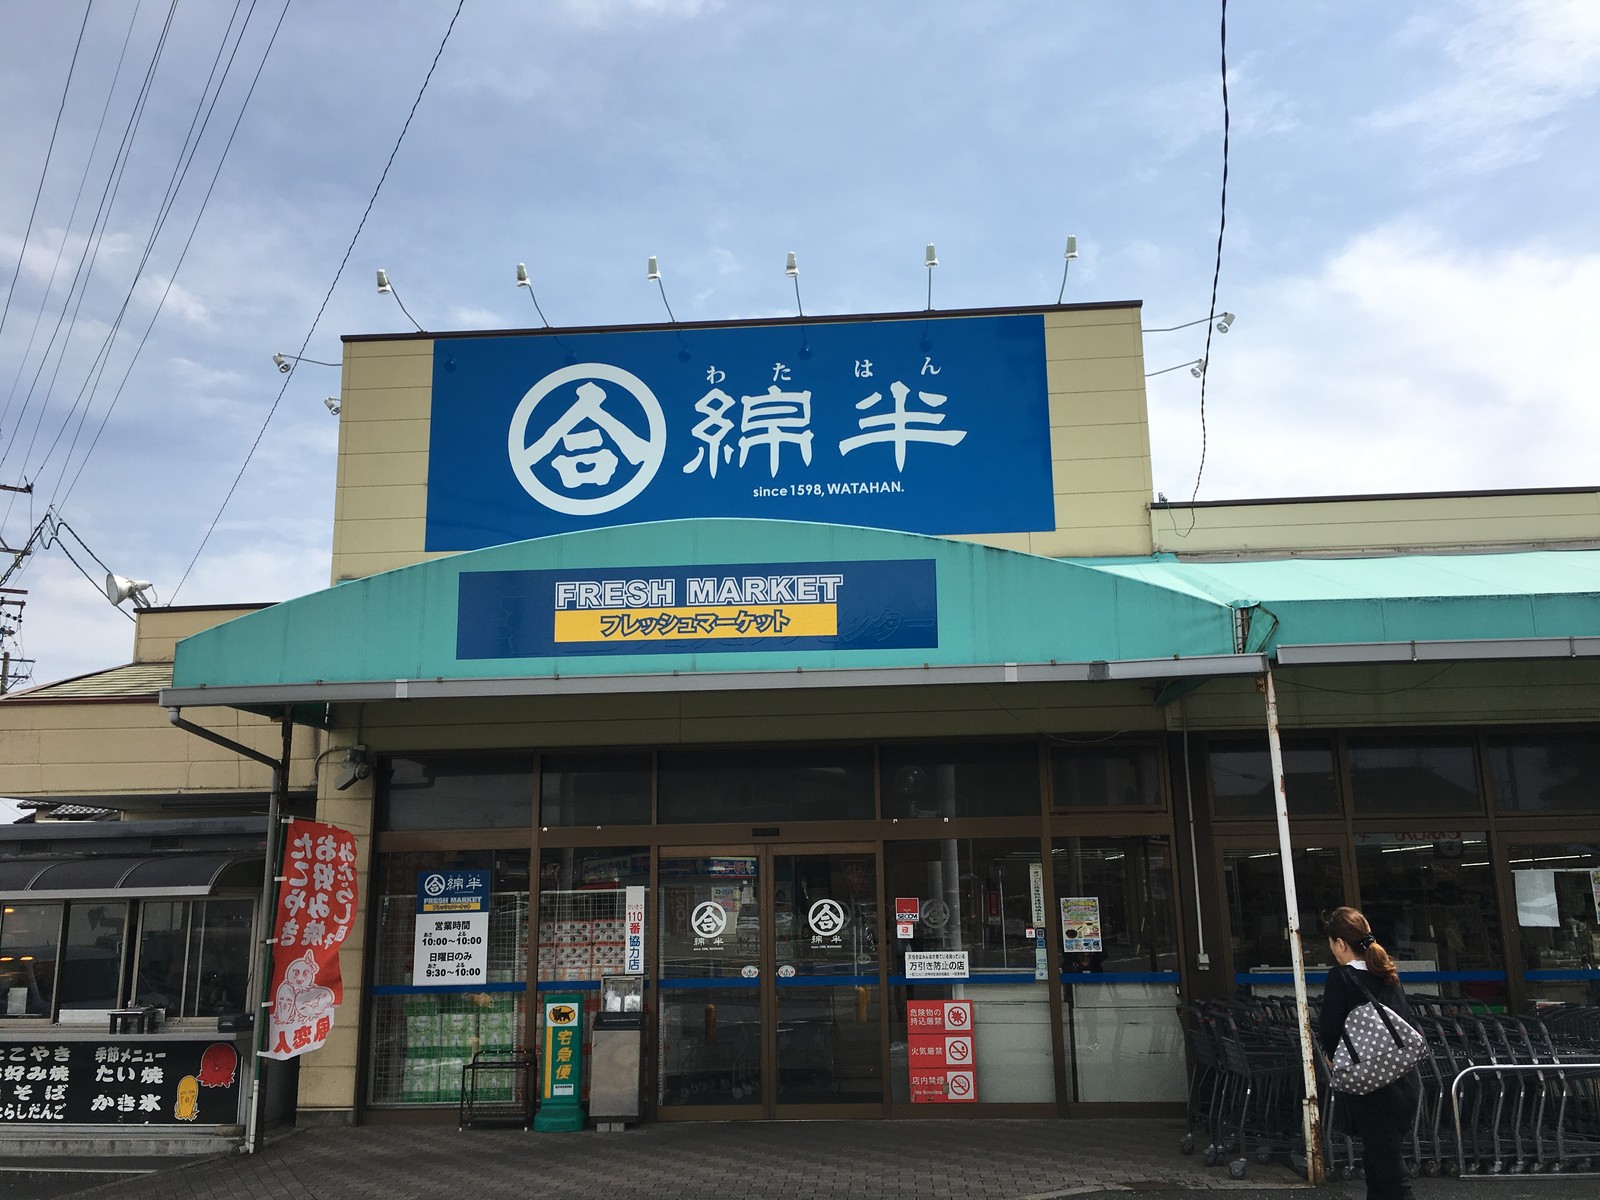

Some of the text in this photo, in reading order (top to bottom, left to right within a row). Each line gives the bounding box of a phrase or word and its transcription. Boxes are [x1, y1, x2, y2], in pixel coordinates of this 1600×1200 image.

[682, 380, 968, 480] 綿半
[753, 481, 905, 498] since 1598, WATAHAN.
[555, 574, 844, 610] FRESH MARKET
[600, 609, 791, 638] フレッシュマーケット
[446, 877, 483, 891] 綿半
[434, 920, 471, 931] 営業時間
[627, 911, 643, 971] 110番協力店
[429, 951, 473, 962] 日曜日のみ
[909, 961, 965, 971] 万引き防止の店
[910, 1008, 942, 1017] 危険物の
[910, 1017, 942, 1026] 持込厳禁
[95, 1046, 167, 1063] 季節メニュー
[555, 1029, 573, 1080] 宅急便
[911, 1047, 943, 1056] 火気厳禁
[0, 1065, 70, 1082] 好み焼
[95, 1064, 164, 1084] たい焼
[912, 1076, 945, 1085] 店内禁煙
[0, 1083, 69, 1101] そば
[0, 1102, 67, 1120] らしだんご
[90, 1094, 162, 1112] かき氷
